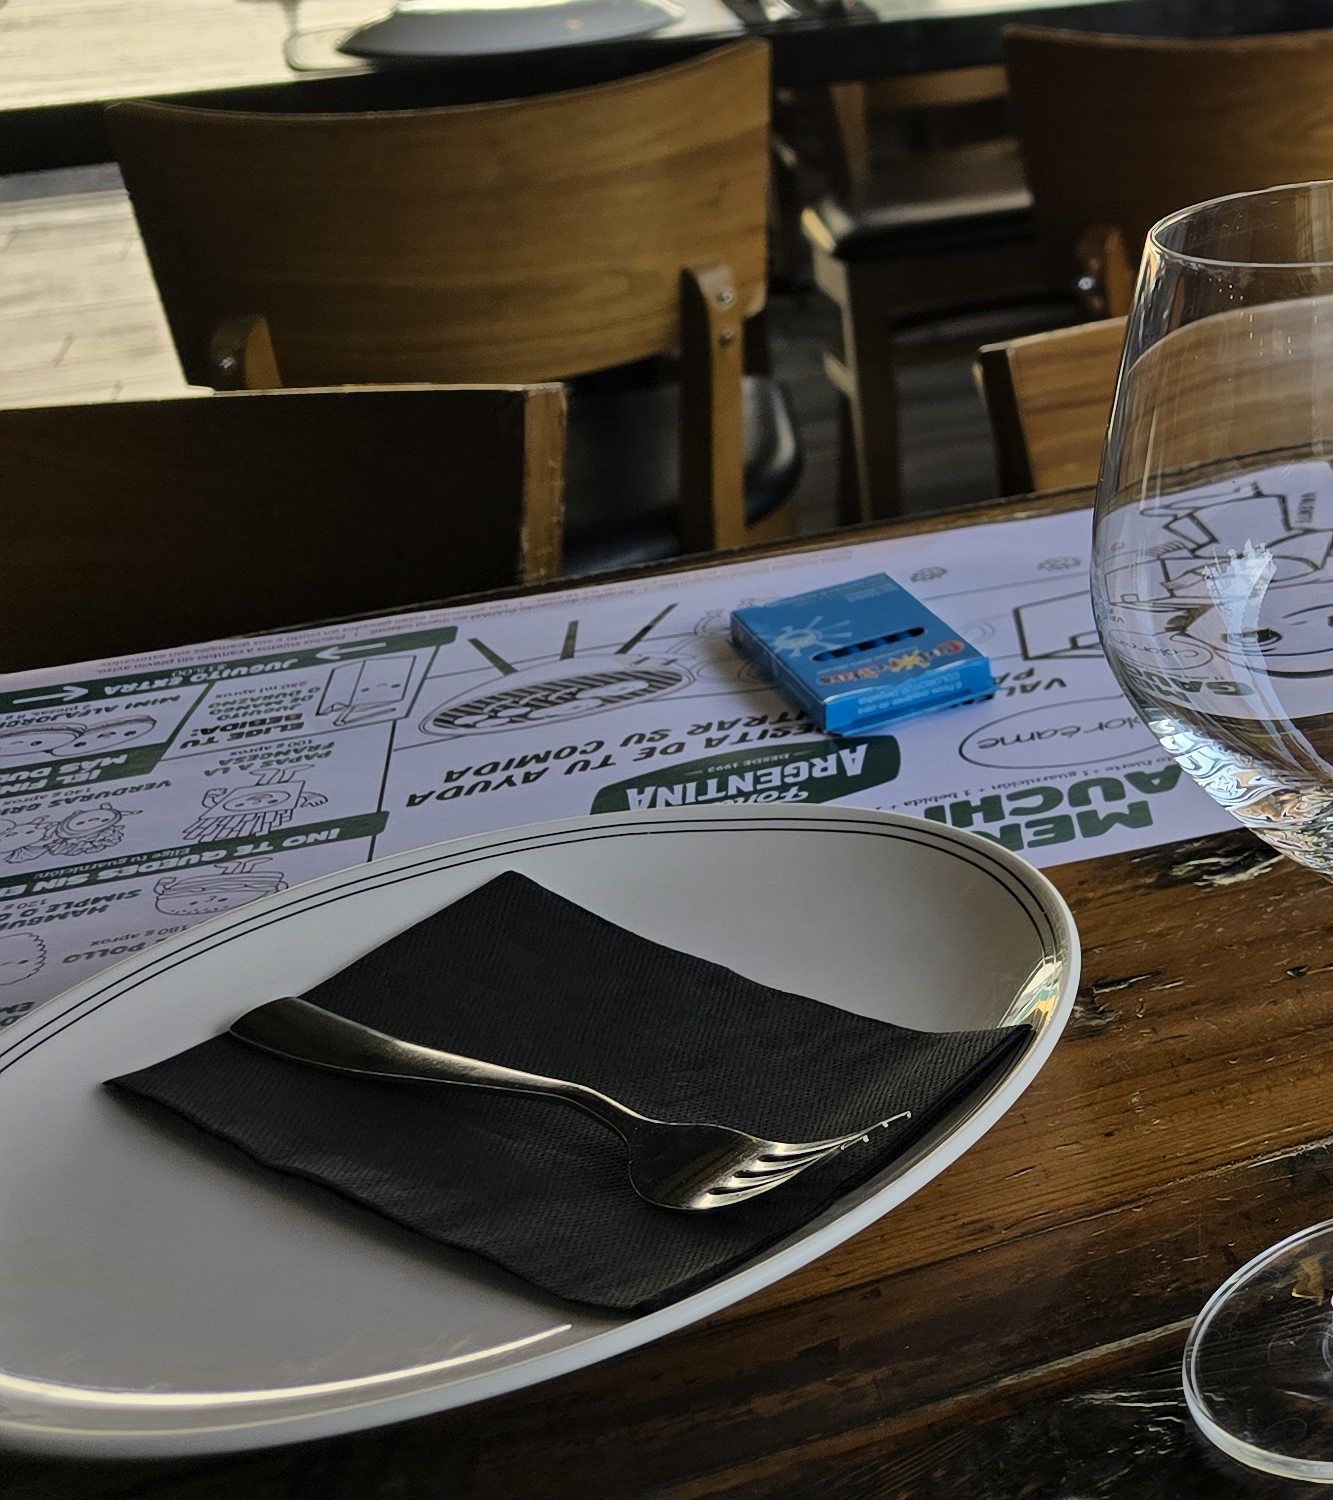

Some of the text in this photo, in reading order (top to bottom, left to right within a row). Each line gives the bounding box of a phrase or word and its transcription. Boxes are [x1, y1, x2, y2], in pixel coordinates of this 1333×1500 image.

[104, 659, 298, 695] JUGUITO EXTRA
[125, 695, 180, 709] MINI
[209, 700, 283, 715] MANGO
[217, 703, 300, 721] JUGUITO
[179, 722, 304, 749] ELIGE TU
[190, 713, 303, 737] BEBIDA:
[618, 727, 672, 747] SU
[219, 741, 334, 766] FRANCESA
[260, 751, 332, 768] PAPAS
[443, 739, 604, 783] COMIDA
[630, 742, 685, 764] DE
[58, 754, 127, 775] MÁS
[204, 767, 230, 777] LA
[564, 755, 618, 777] TU
[623, 743, 868, 809] ARGENTINA
[991, 770, 1077, 792] guarnición
[48, 780, 172, 808] VERDURAS
[404, 768, 543, 808] AYUDA
[903, 791, 957, 808] bebida
[155, 847, 190, 861] Elige
[233, 841, 273, 857] TE
[97, 850, 227, 880] QUEDES
[33, 873, 90, 892] SIN
[20, 907, 38, 918] O
[45, 889, 142, 915] SIMPLE
[90, 932, 141, 947] aprox
[63, 942, 146, 964] POLLO
